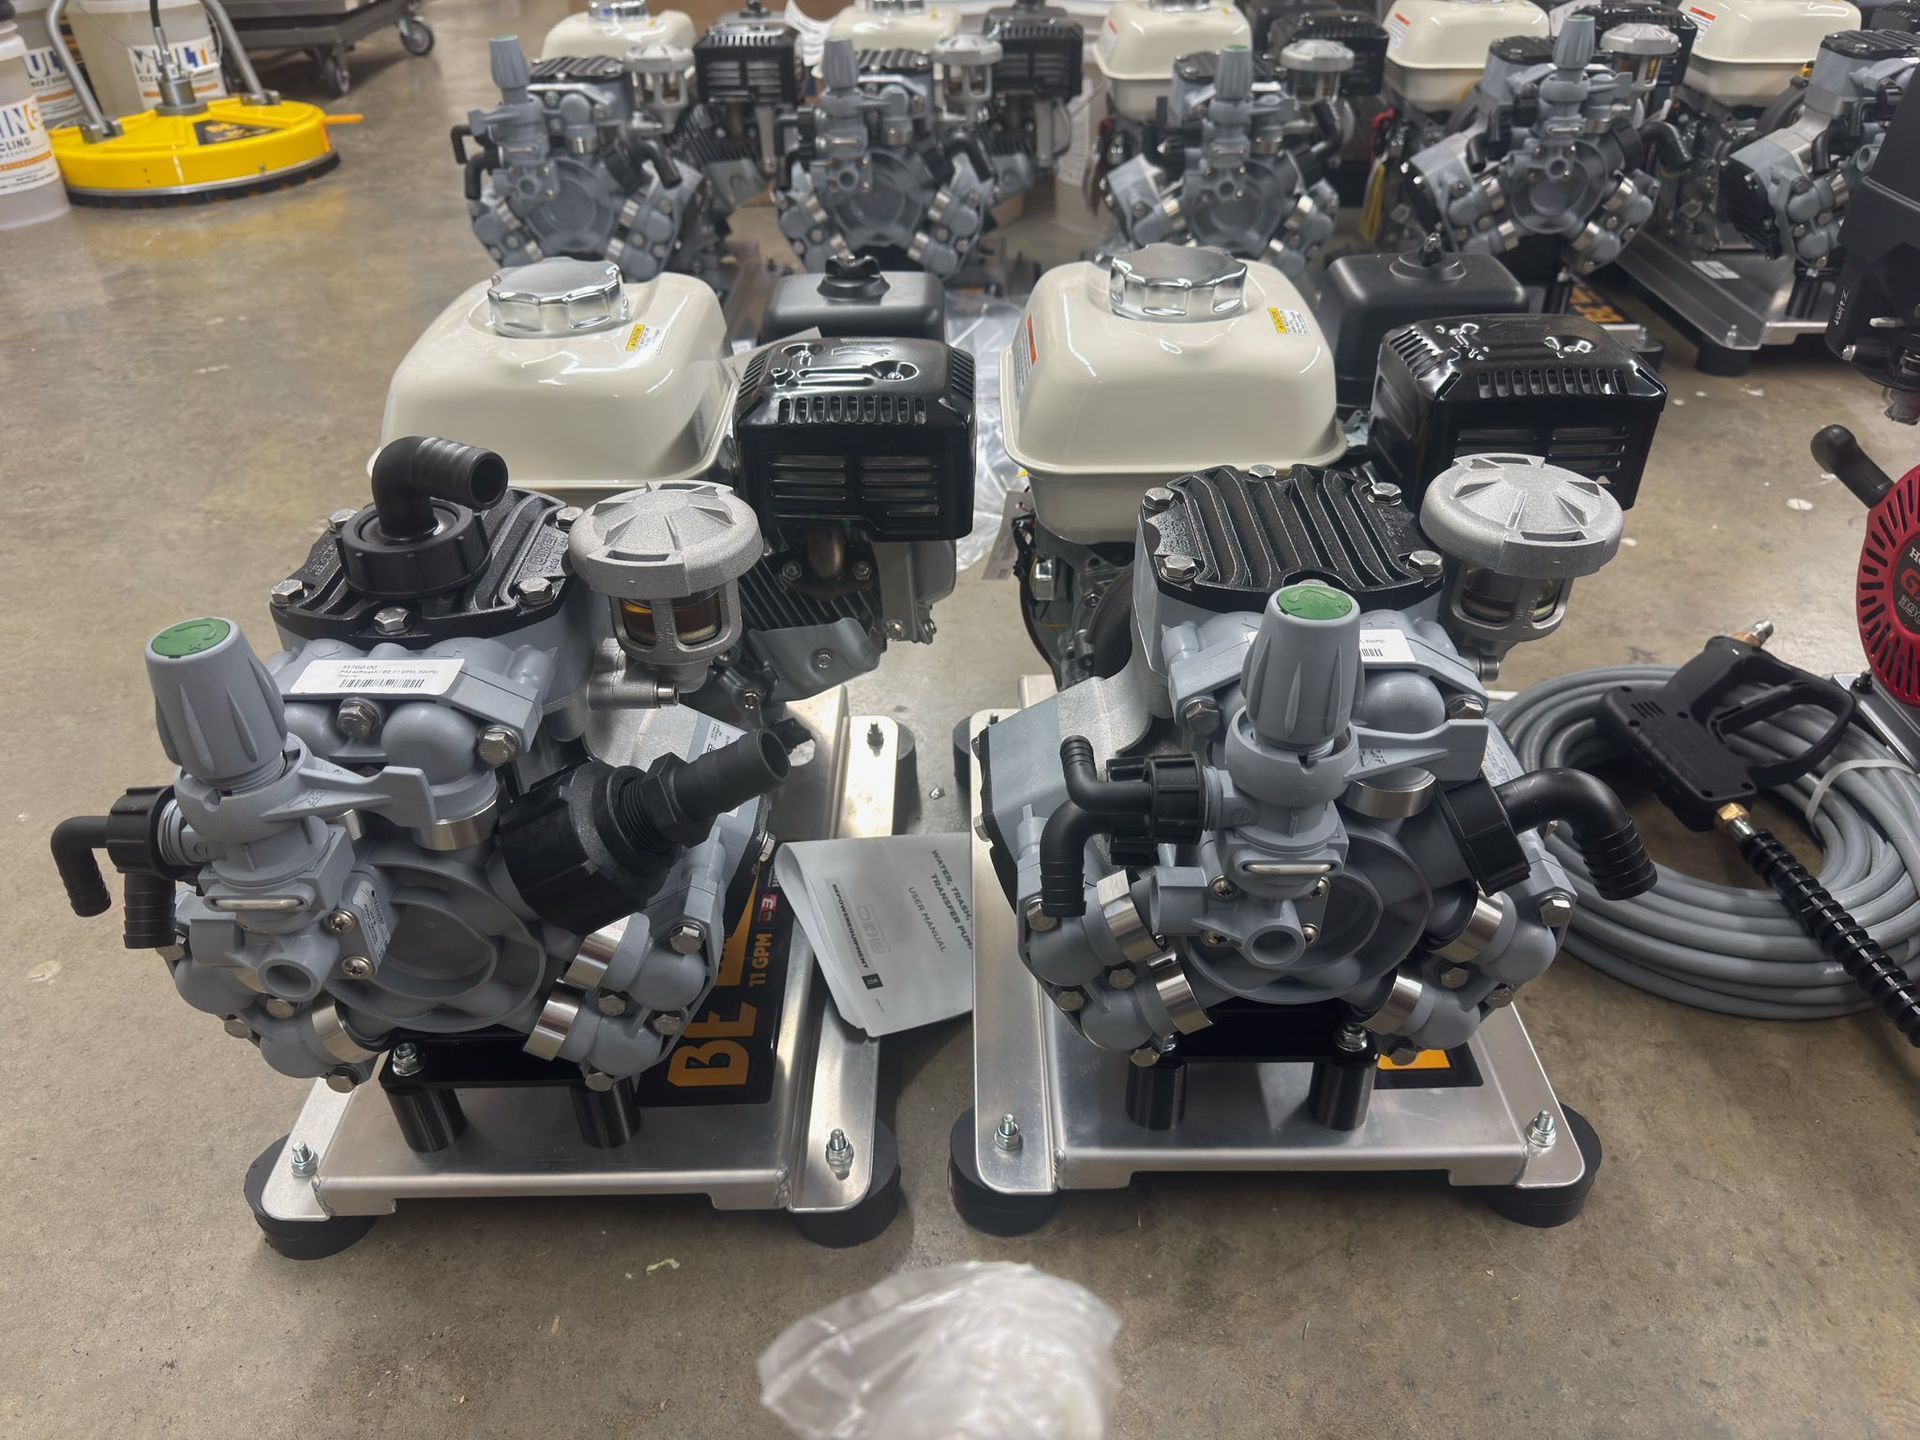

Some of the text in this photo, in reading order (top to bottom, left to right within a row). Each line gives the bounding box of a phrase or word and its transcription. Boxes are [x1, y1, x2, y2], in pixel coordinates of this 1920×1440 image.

[930, 873, 961, 924] TRANSFER
[932, 849, 971, 921] WATER, TRASH,
[752, 932, 773, 969] GPM
[908, 886, 947, 952] USER MANUAL
[667, 1001, 758, 1087] BE
